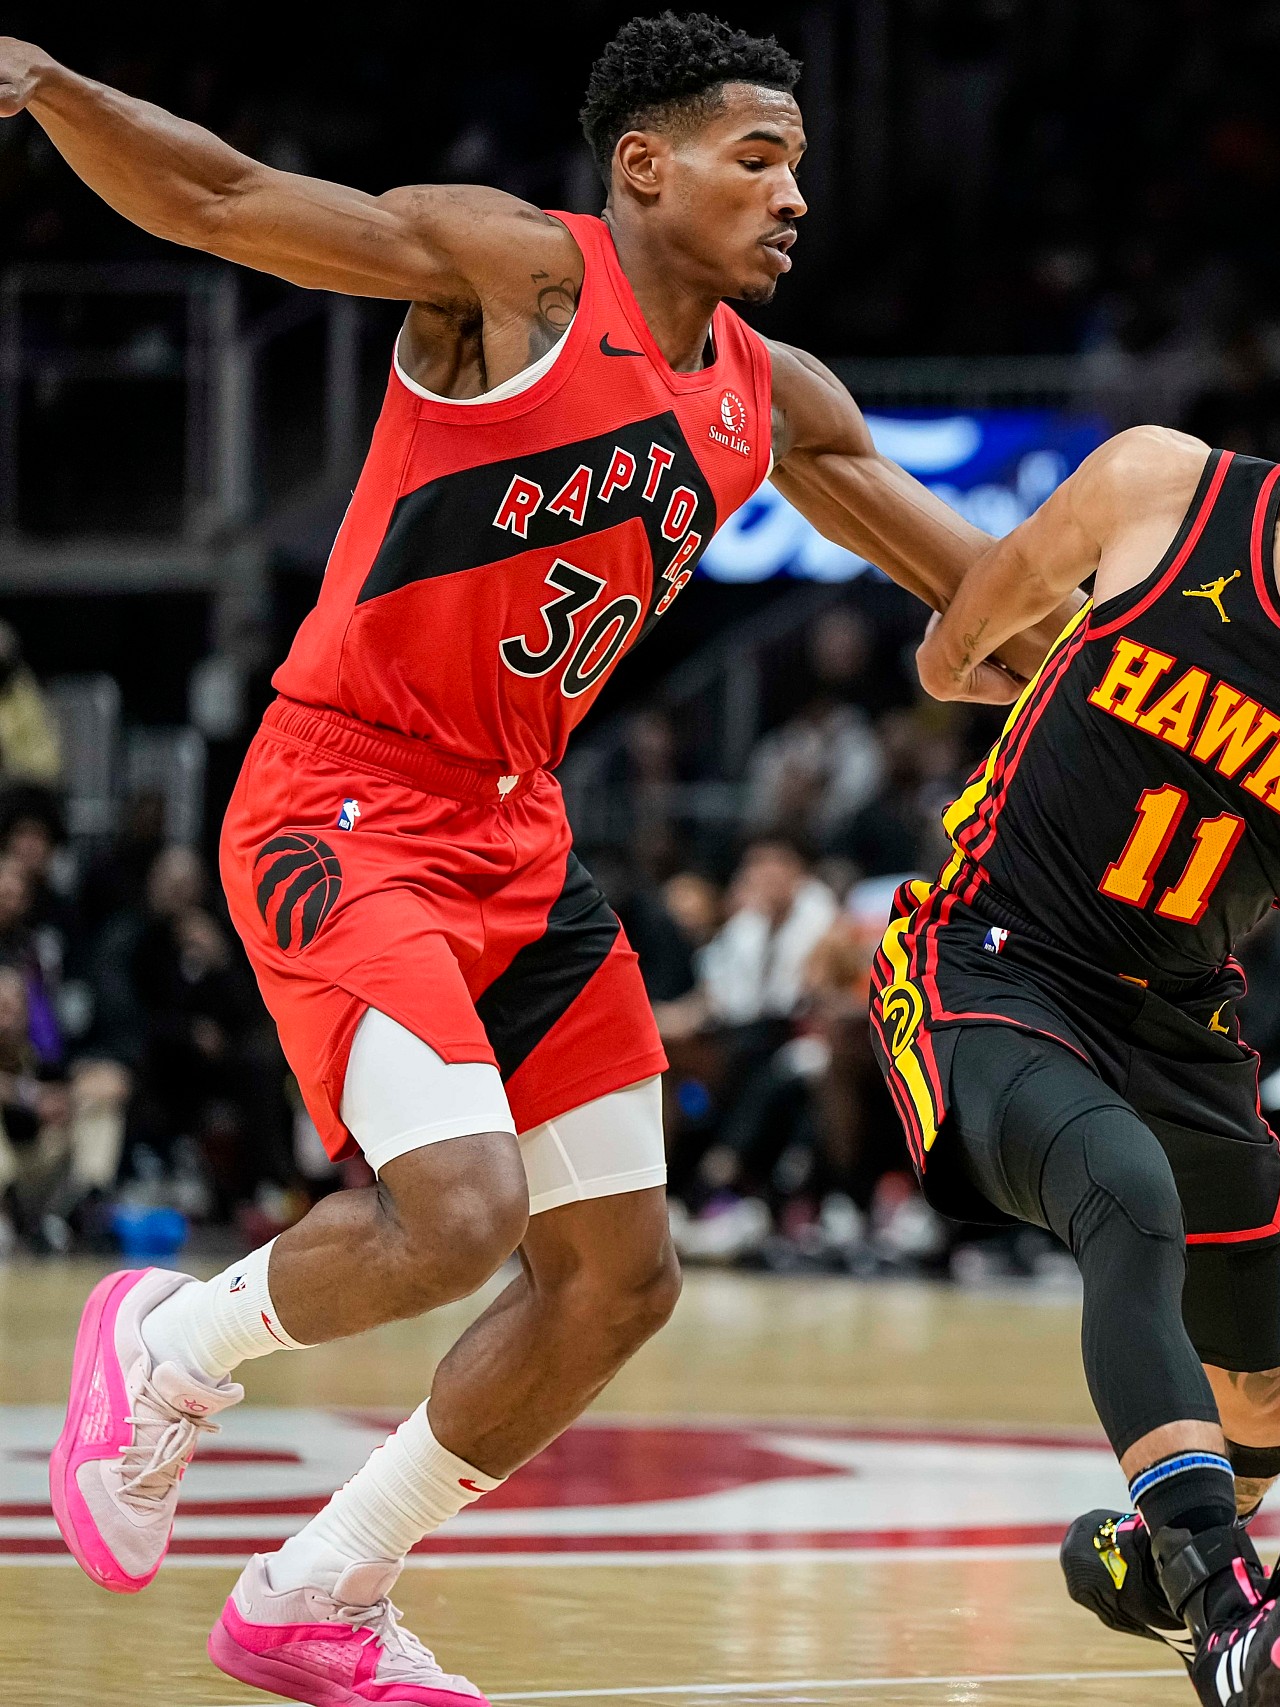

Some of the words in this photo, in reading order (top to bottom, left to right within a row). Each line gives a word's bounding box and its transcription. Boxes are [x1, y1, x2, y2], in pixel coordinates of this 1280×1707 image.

[708, 425, 729, 446] Sun
[730, 435, 751, 456] Life
[492, 441, 702, 616] RAPTORS
[499, 557, 642, 699] 30
[1097, 782, 1246, 926] 11
